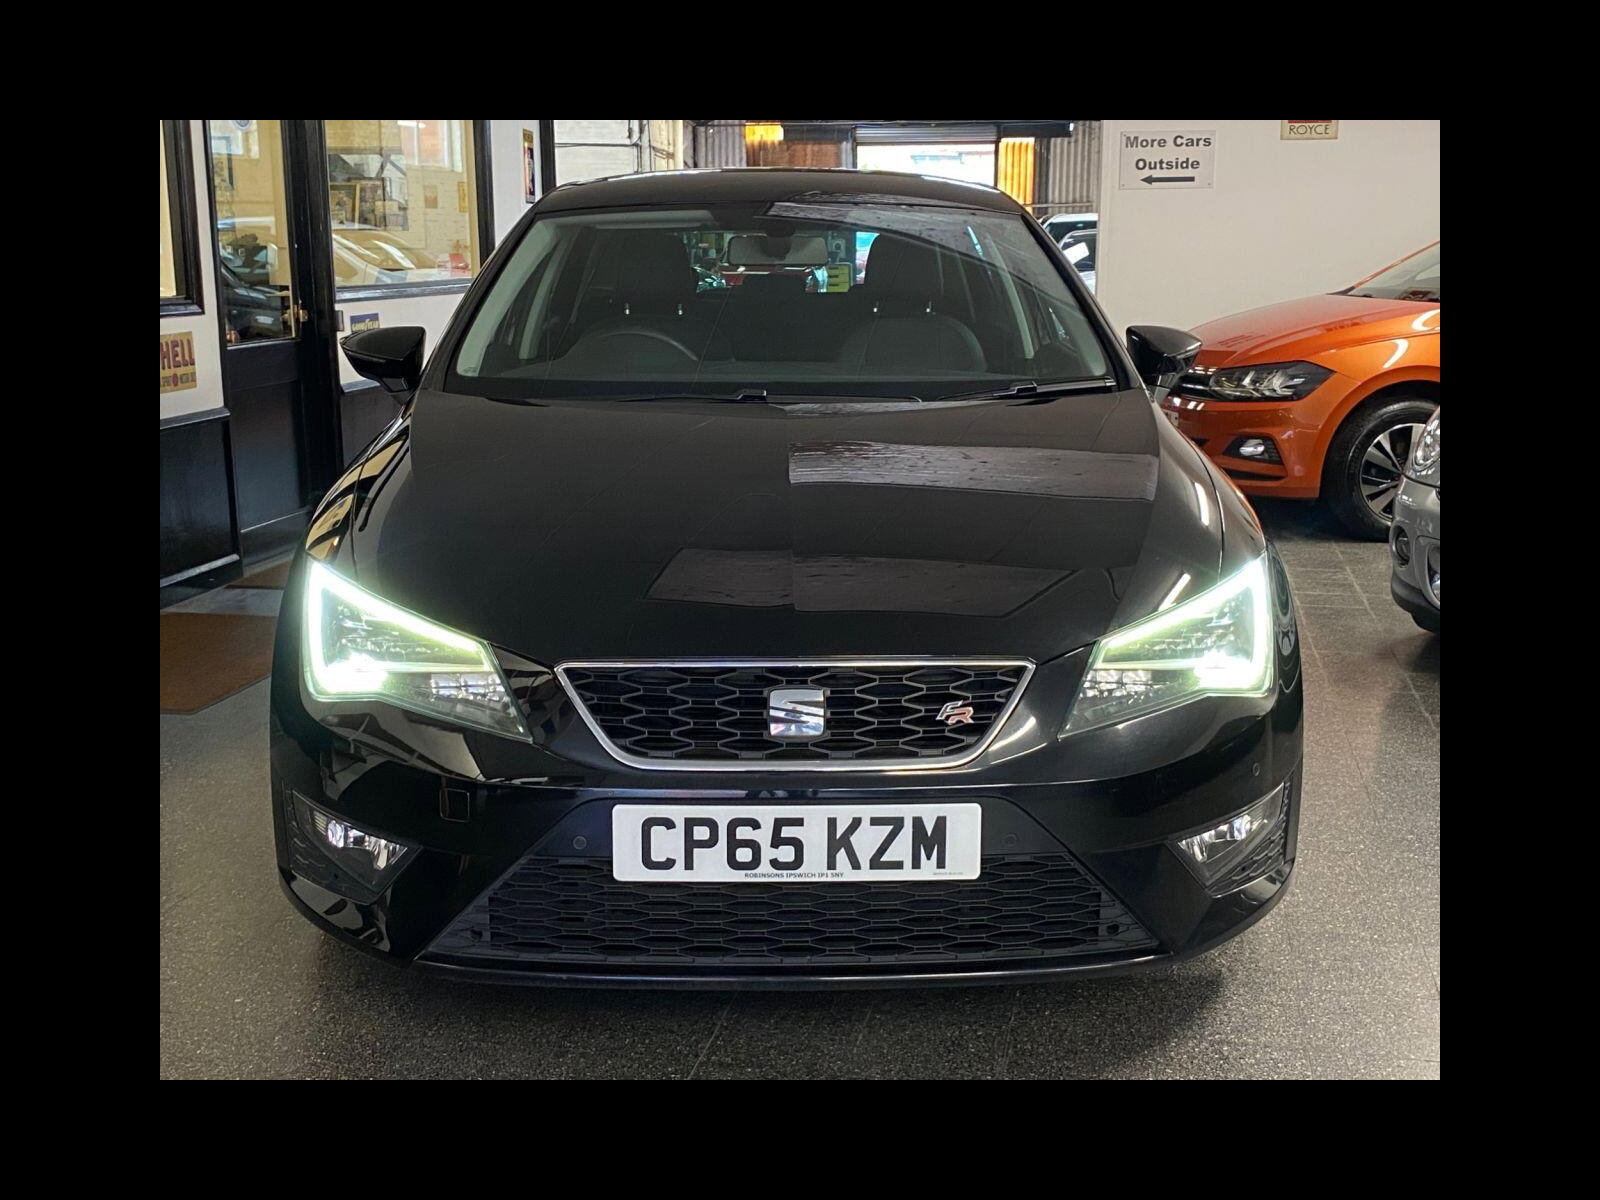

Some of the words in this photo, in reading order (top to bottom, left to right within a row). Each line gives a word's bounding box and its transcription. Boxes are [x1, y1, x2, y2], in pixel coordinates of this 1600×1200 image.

[1288, 124, 1330, 135] ROYCE
[1125, 136, 1167, 148] More
[1173, 135, 1212, 147] Cars
[1135, 157, 1201, 170] Outside
[641, 816, 805, 871] CP65
[826, 815, 948, 871] KZM
